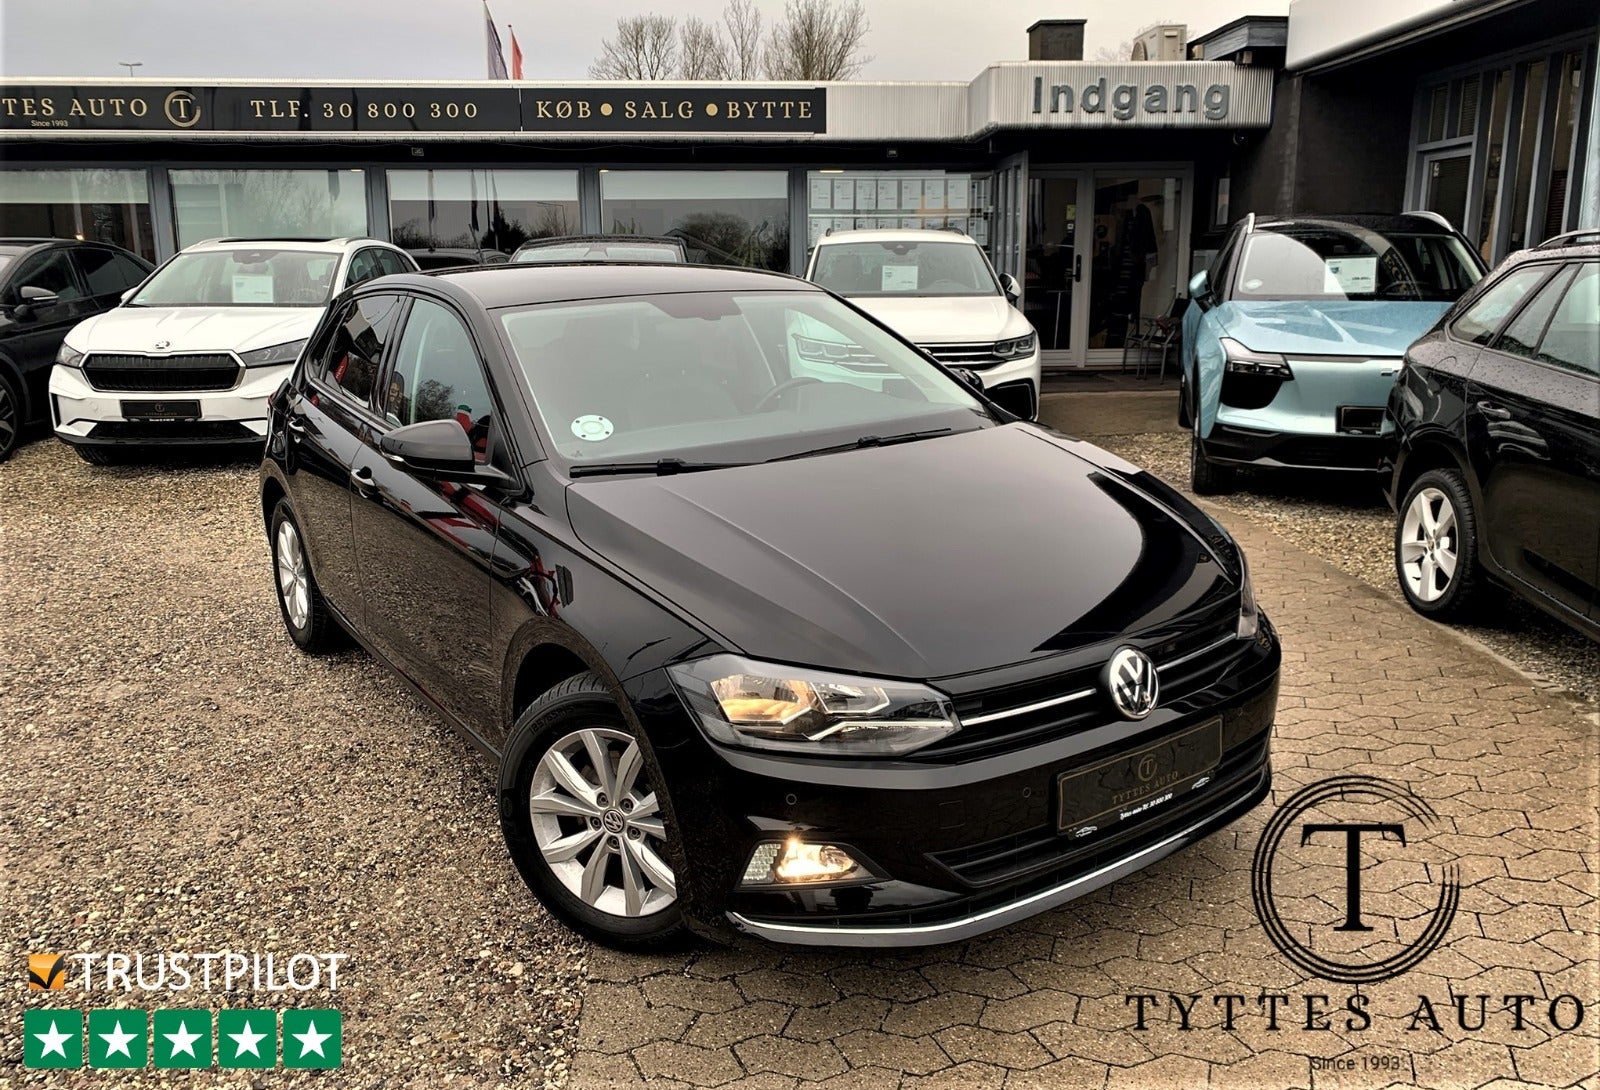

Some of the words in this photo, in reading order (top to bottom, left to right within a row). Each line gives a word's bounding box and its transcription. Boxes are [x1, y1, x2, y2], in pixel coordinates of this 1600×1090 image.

[2, 98, 55, 116] TES
[69, 98, 148, 117] AUTO
[1032, 76, 1230, 121] Indgang
[250, 100, 308, 118] TLF.
[323, 103, 353, 118] 30
[367, 103, 416, 119] 800
[430, 103, 478, 119] 300
[536, 100, 592, 119] KØB
[625, 100, 694, 119] SALG
[727, 100, 813, 119] BYTTE
[1112, 783, 1151, 805] TYTTES
[1154, 771, 1178, 788] AUTO
